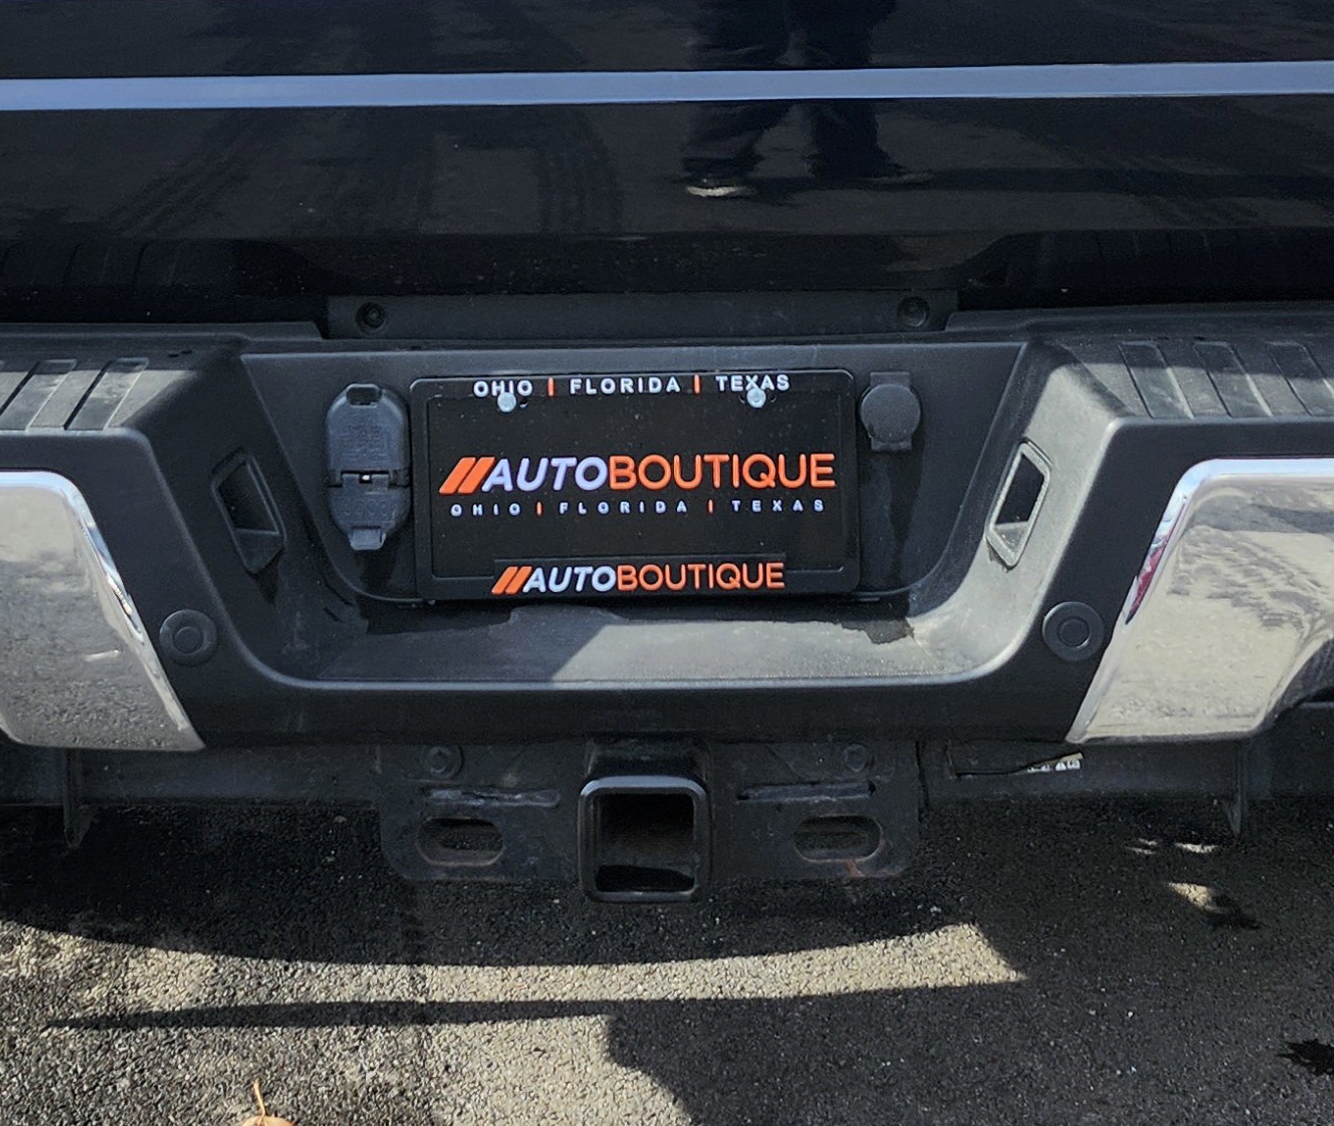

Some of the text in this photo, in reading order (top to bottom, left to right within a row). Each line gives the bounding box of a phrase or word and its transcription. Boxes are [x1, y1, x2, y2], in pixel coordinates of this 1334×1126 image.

[473, 374, 790, 397] OHIO FLORIDA TEXAS
[481, 453, 836, 492] AUTOBOUTIQUE
[450, 498, 825, 517] OHIO FLORIDA TEXAS
[522, 562, 786, 593] AUTOBOUTIQUE
